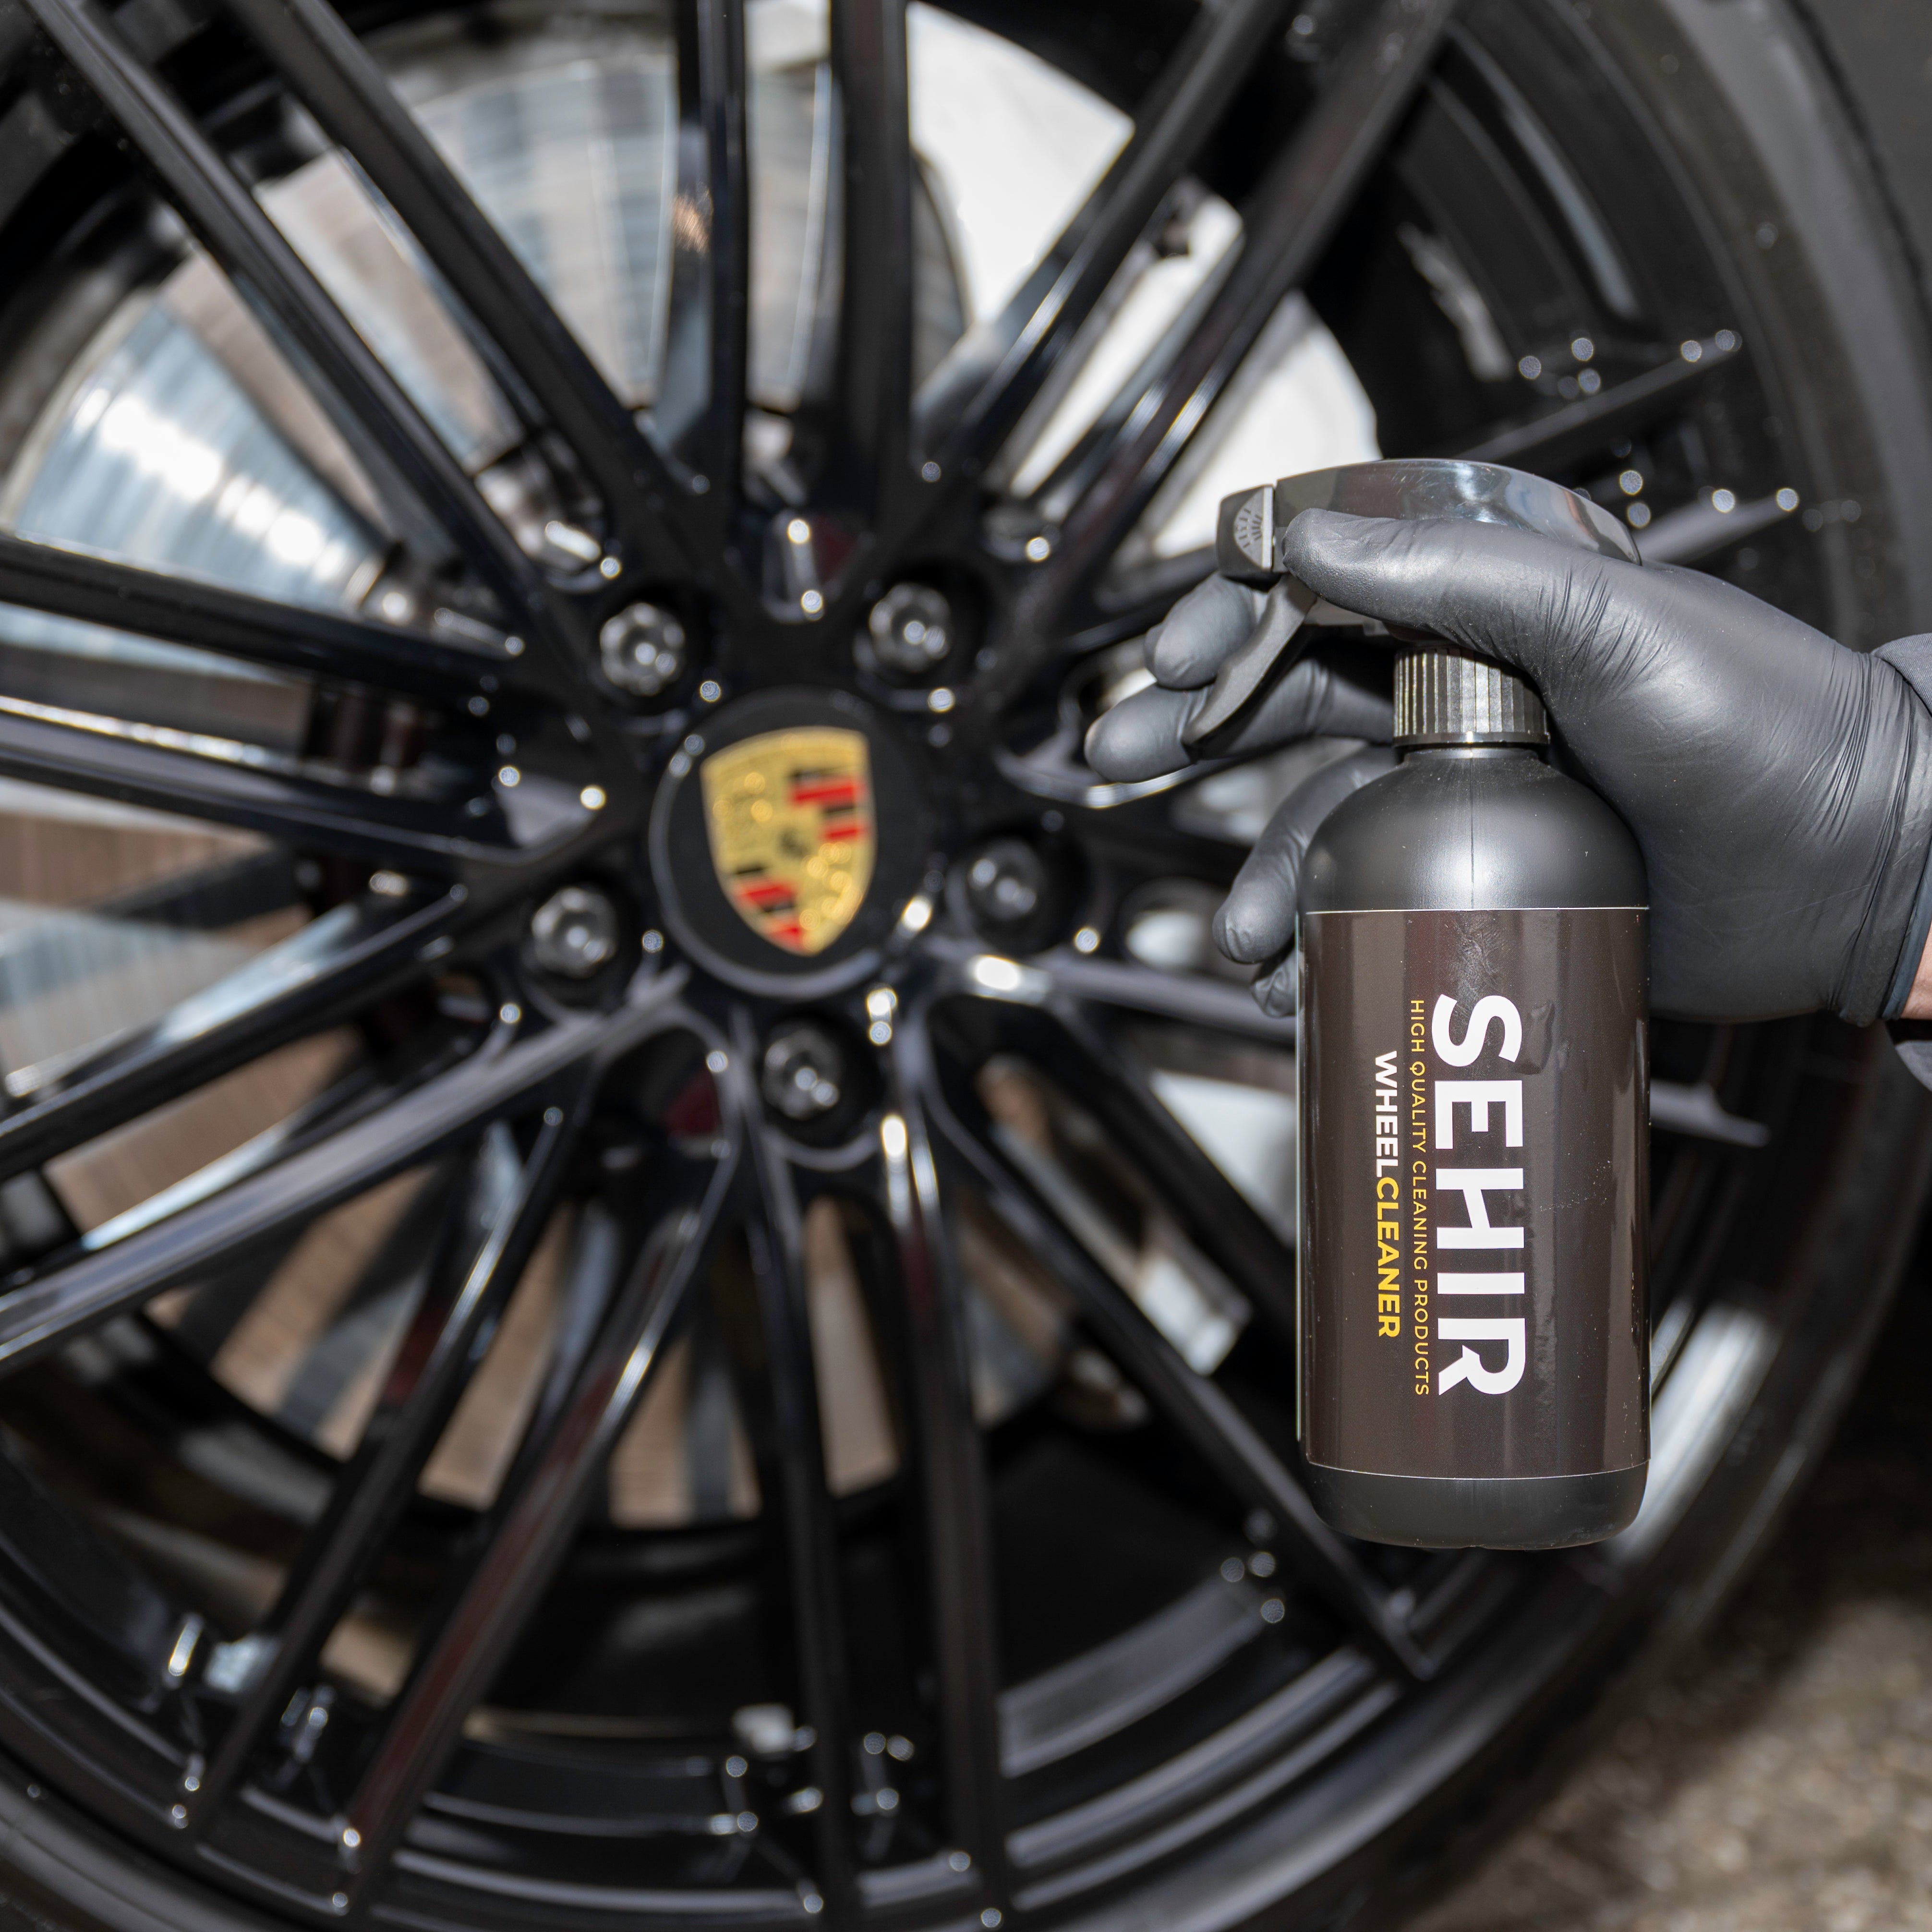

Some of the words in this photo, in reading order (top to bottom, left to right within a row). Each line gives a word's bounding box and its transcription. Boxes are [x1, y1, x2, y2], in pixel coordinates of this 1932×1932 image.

[1411, 999, 1425, 1052] HIGH
[1410, 1061, 1426, 1153] QUALITY
[1375, 1050, 1401, 1338] WHEELCLEANER
[1413, 1160, 1428, 1270] CLEANING
[1431, 994, 1526, 1396] SEHIR
[1414, 1279, 1429, 1395] PRODUCTS
